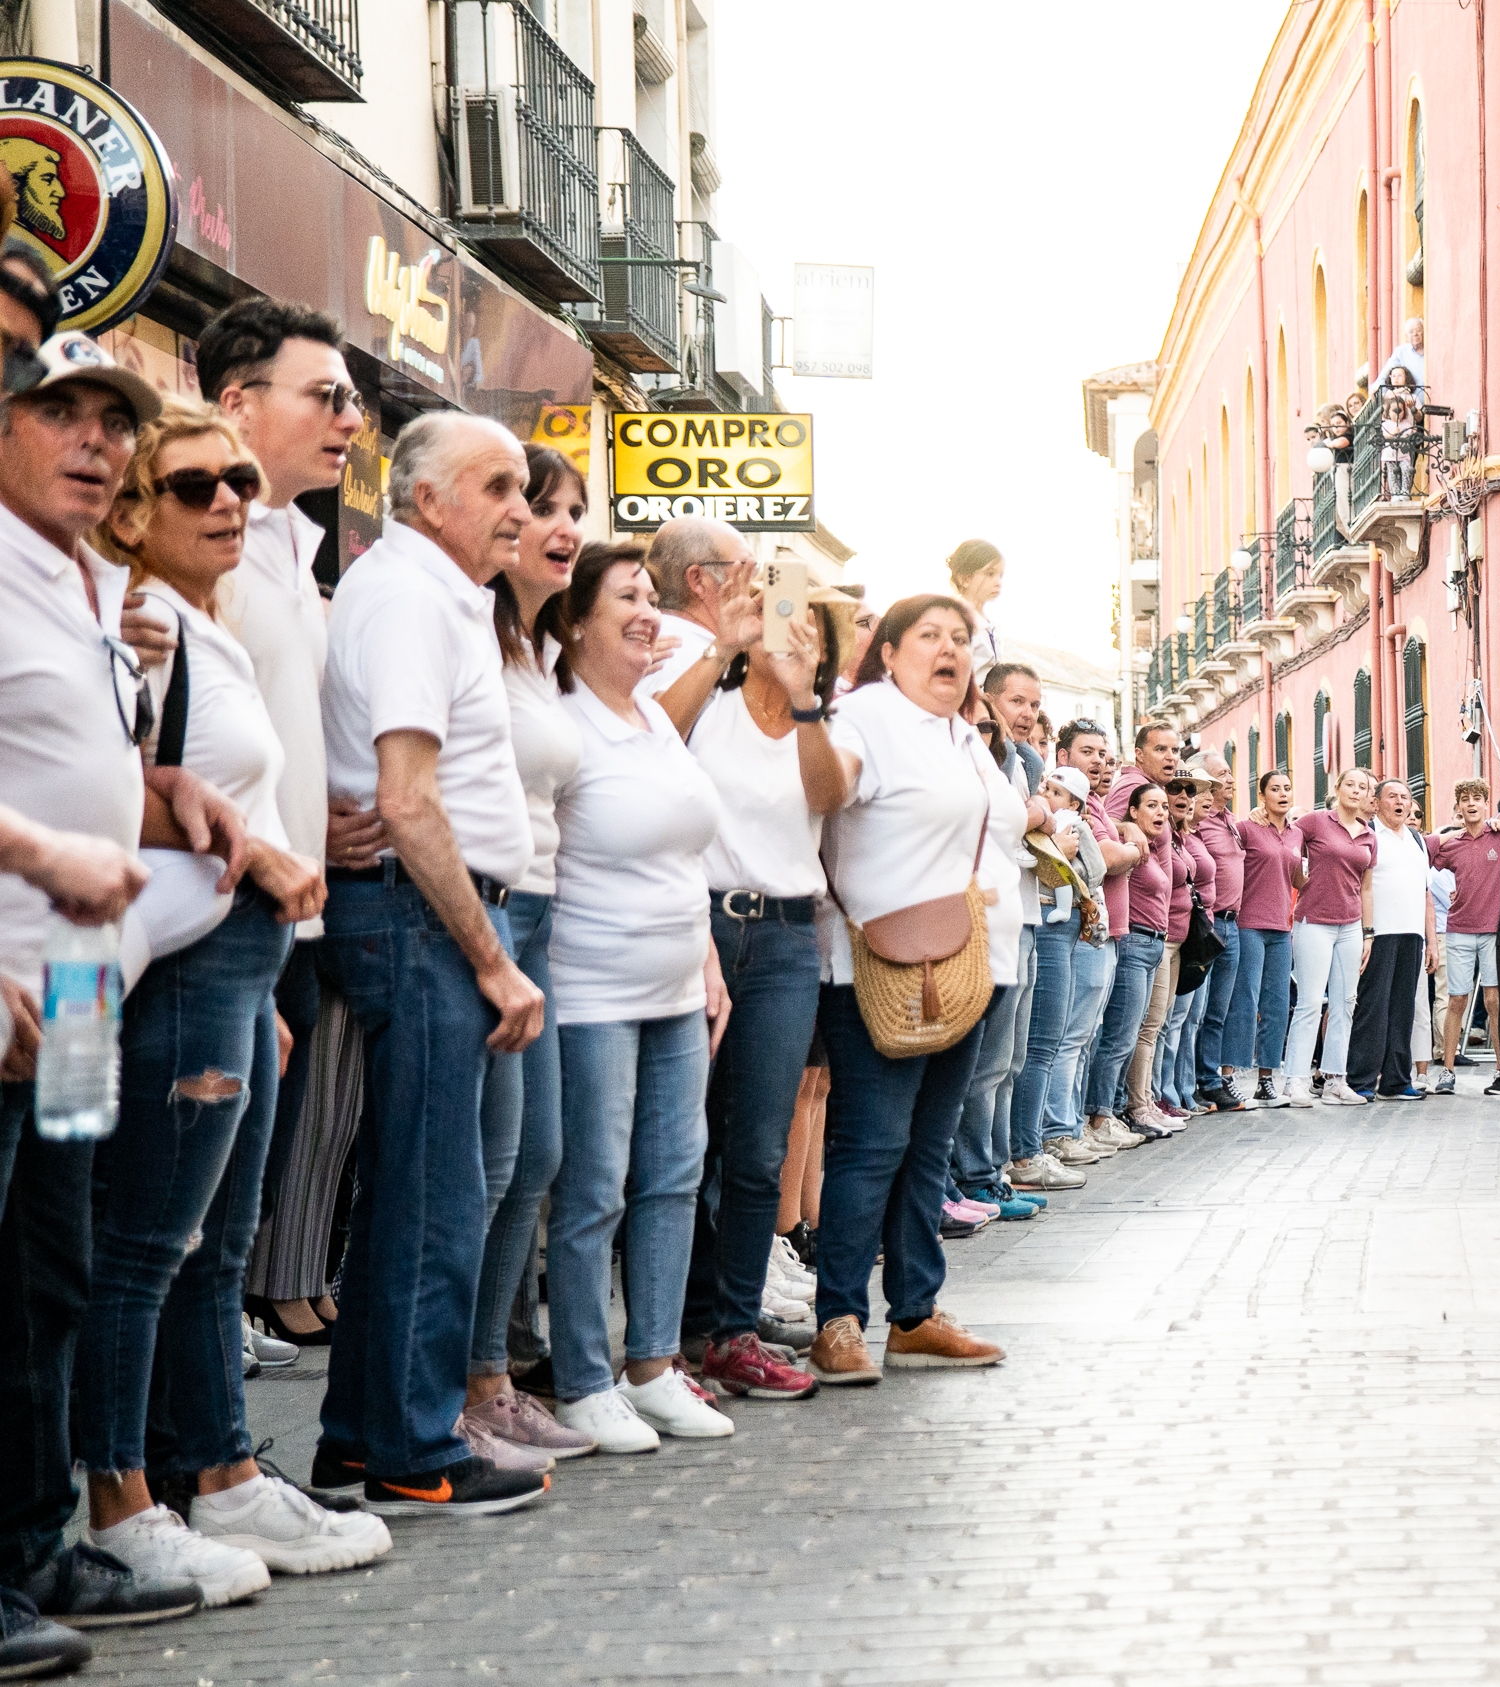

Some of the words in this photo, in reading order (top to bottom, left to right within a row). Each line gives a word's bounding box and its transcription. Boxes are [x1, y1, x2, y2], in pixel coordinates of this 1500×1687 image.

[0, 79, 142, 198] LANER
[795, 361, 818, 372] 957
[822, 362, 844, 374] 502
[847, 363, 870, 375] 098
[619, 419, 807, 447] COMPRO
[647, 457, 782, 489] ORO
